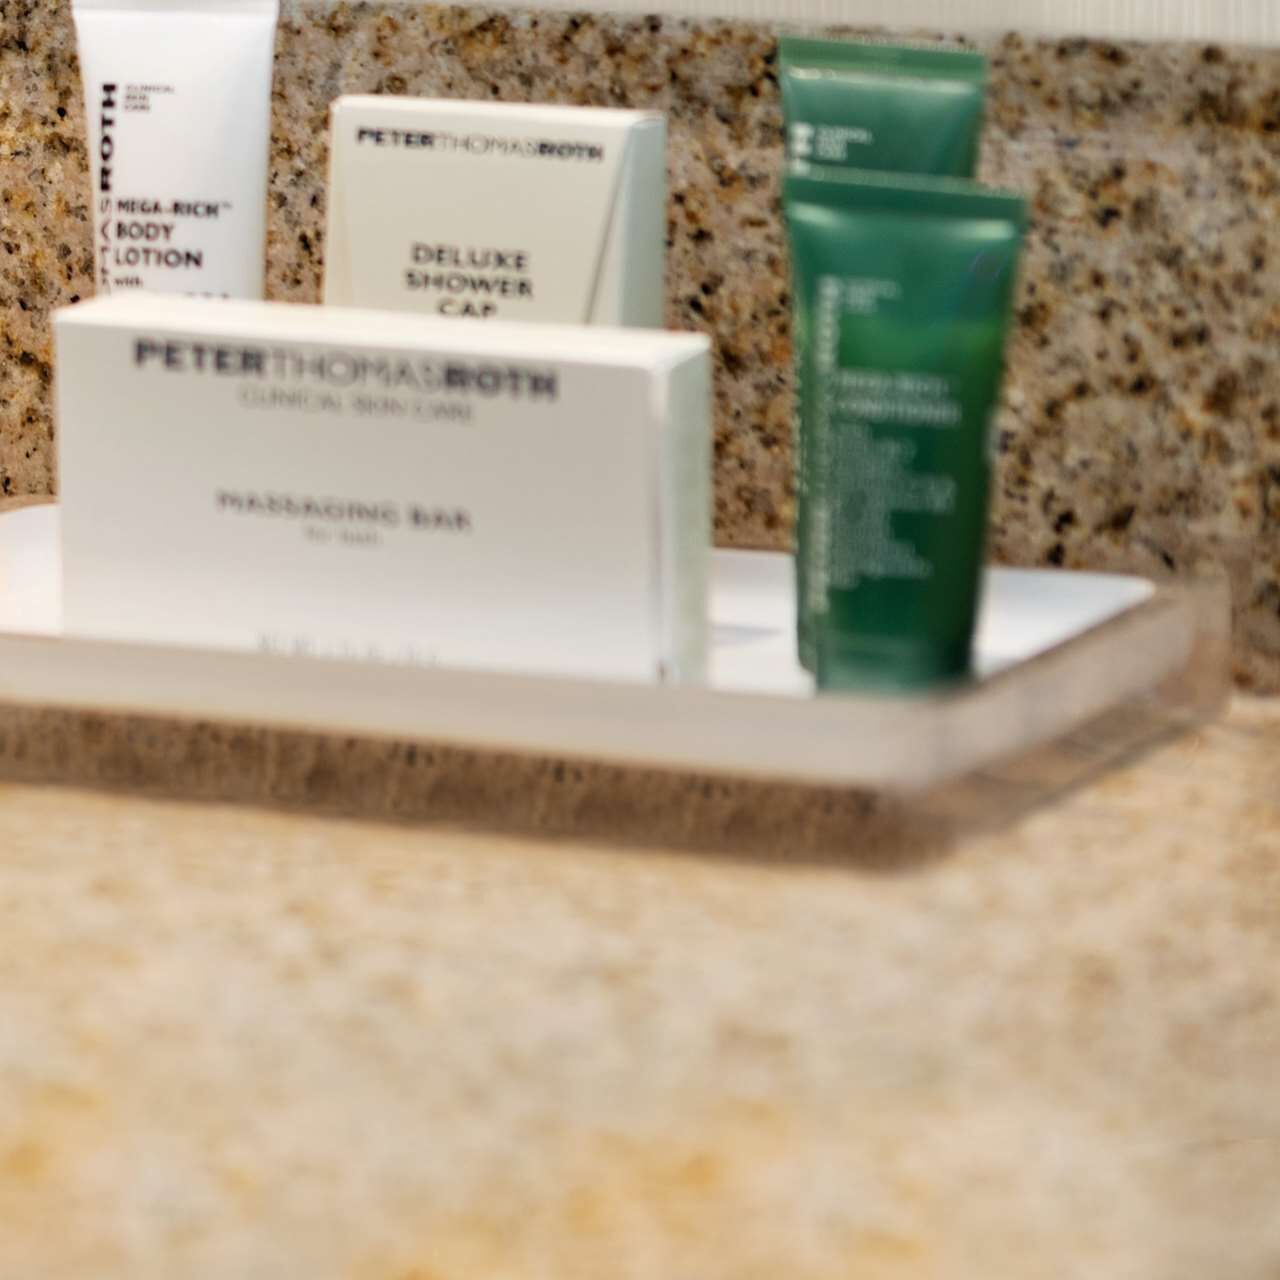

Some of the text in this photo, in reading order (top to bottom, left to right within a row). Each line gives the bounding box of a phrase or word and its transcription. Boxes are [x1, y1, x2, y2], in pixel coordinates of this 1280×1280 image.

[116, 223, 175, 241] BODY
[115, 248, 203, 269] LOTION
[411, 242, 529, 270] DELUXE
[405, 269, 533, 297] SHOWER
[437, 299, 498, 319] CAP
[215, 489, 473, 532] MASSAGING BAR
